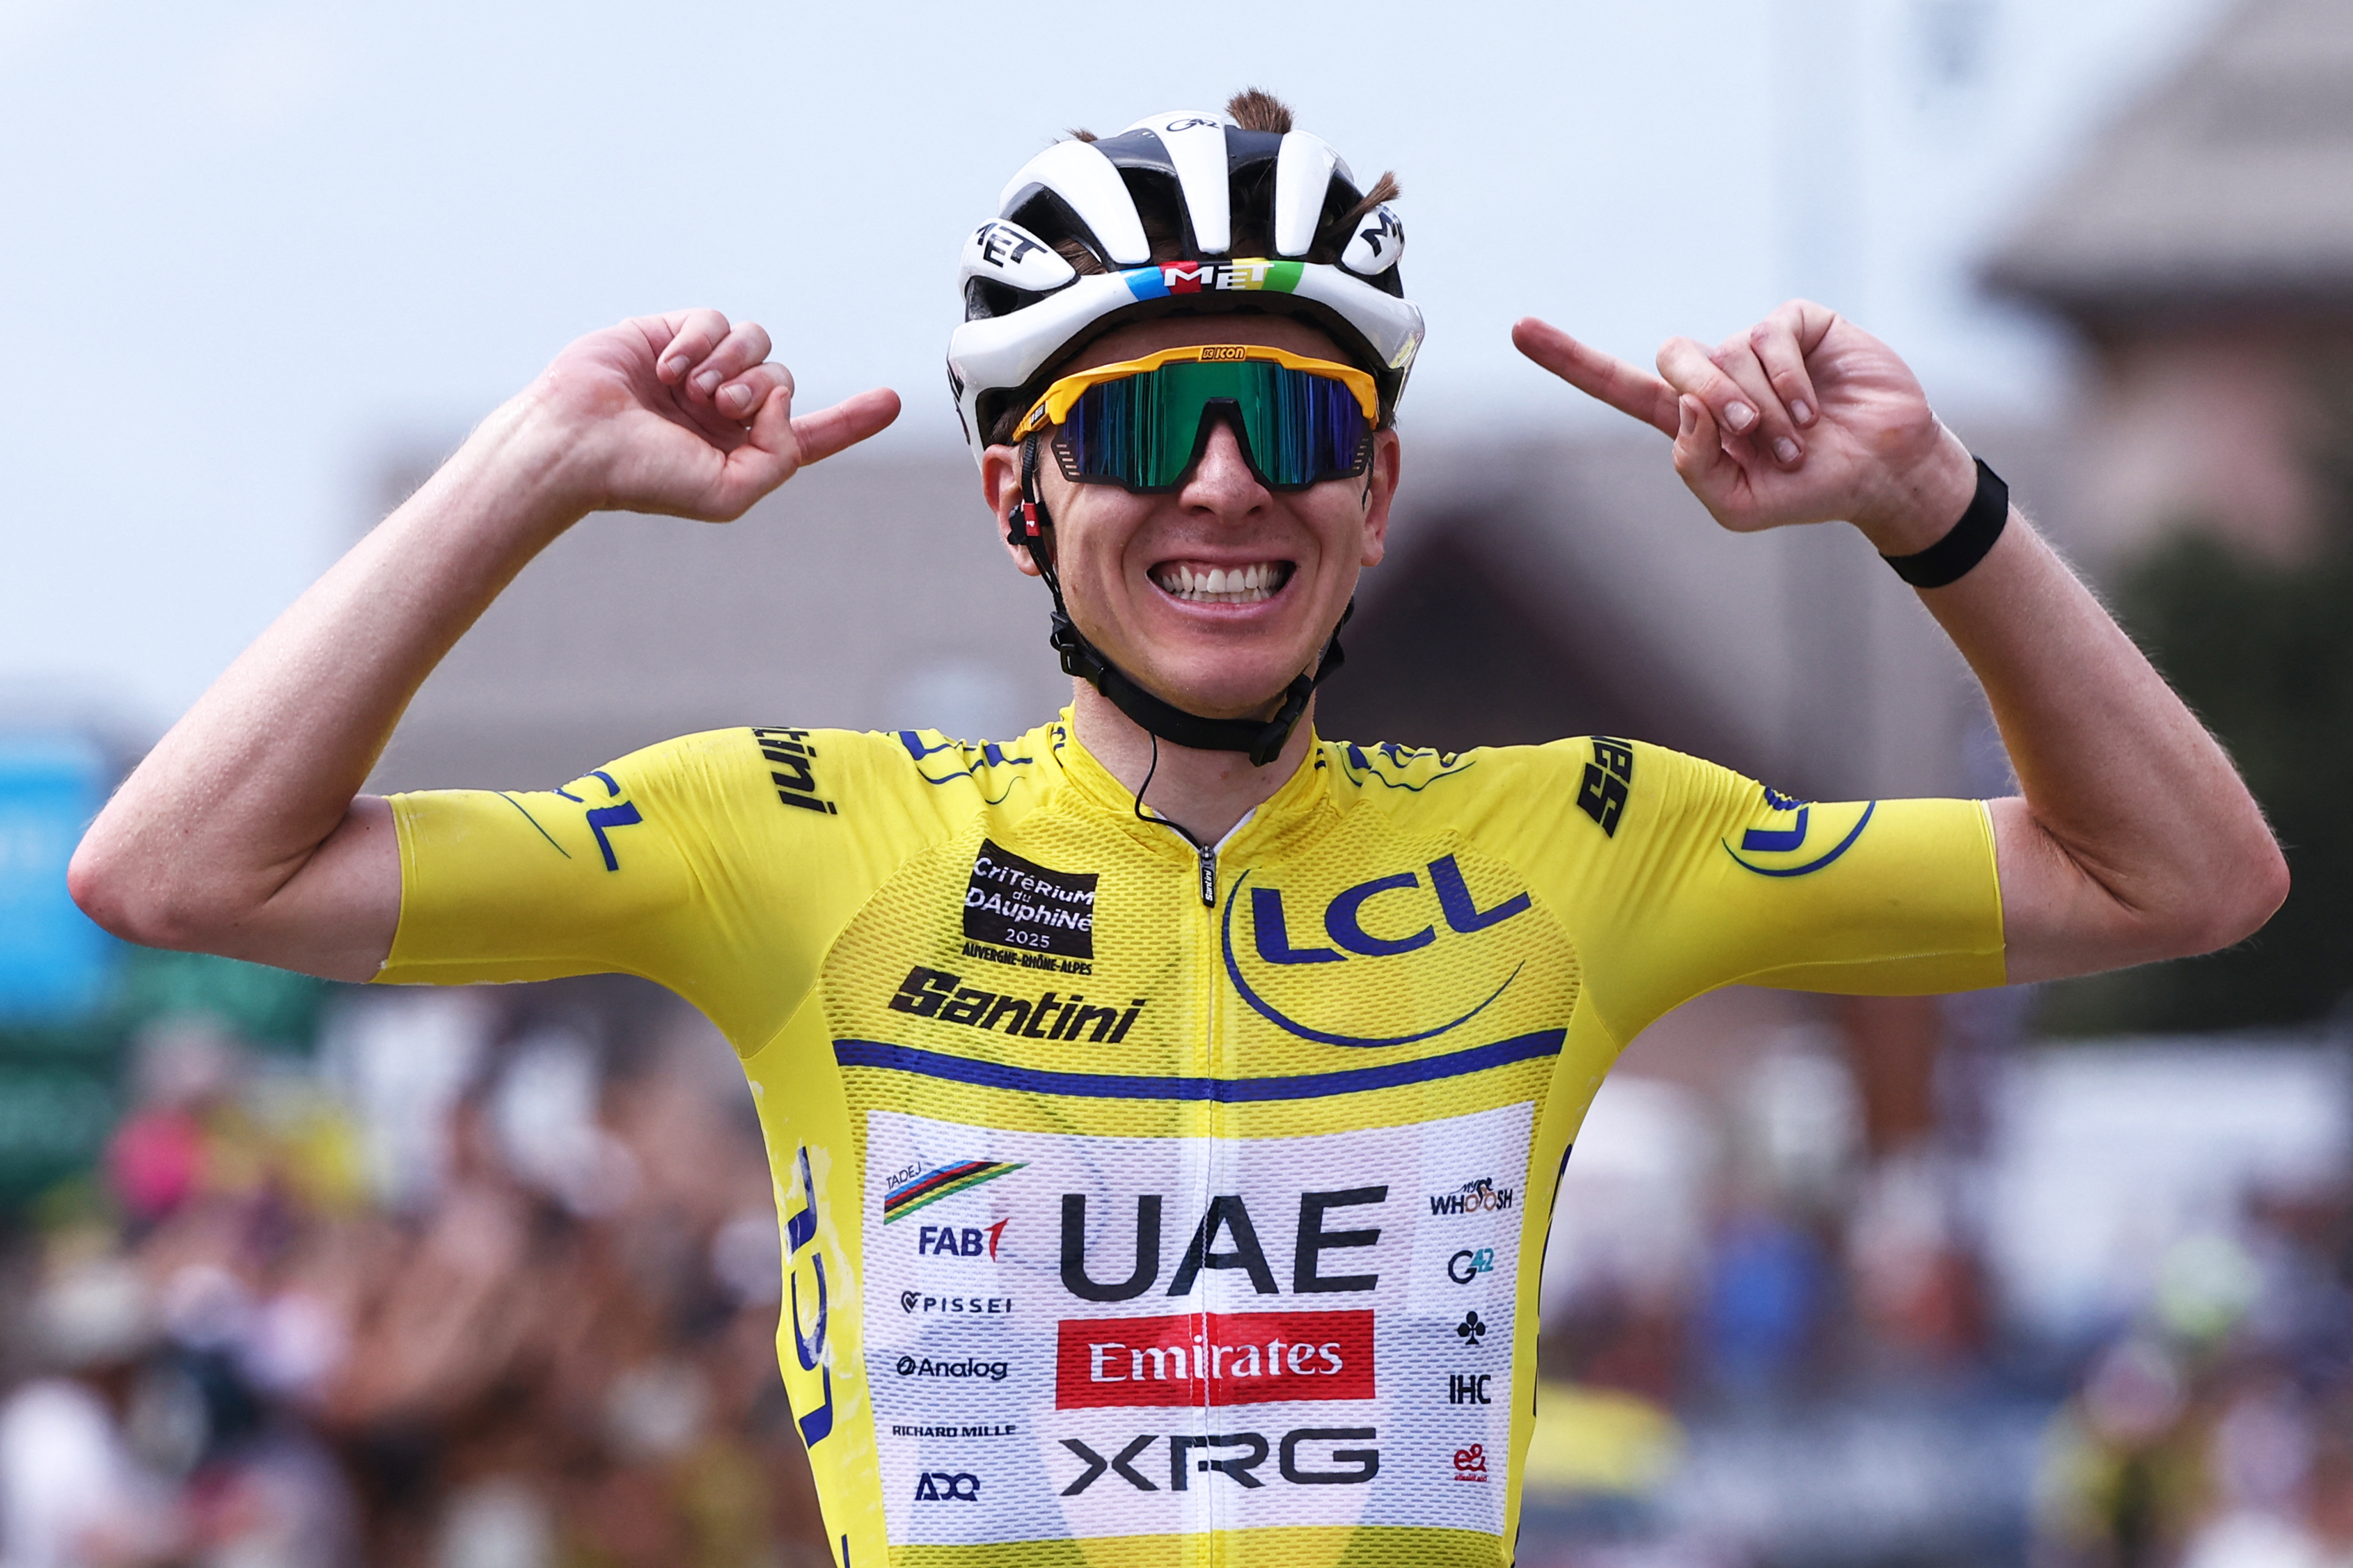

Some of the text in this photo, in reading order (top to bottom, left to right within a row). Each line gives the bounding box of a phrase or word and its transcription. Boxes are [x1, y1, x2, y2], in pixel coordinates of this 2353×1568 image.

[1164, 263, 1275, 290] MET
[1012, 890, 1032, 903] du
[1251, 853, 1532, 965] LCL
[1005, 928, 1050, 949] 2025
[888, 965, 1146, 1044] Santini
[886, 1162, 922, 1189] TADEJ
[1060, 1185, 1389, 1302] UAE
[1448, 1248, 1494, 1284] G42
[924, 1297, 1012, 1313] PISSEI
[918, 1358, 1008, 1381] Analog
[1088, 1334, 1344, 1383] Emirates
[1450, 1375, 1491, 1404] IHC
[892, 1425, 1017, 1437] RICHARD MILLE
[1058, 1427, 1379, 1497] XRG
